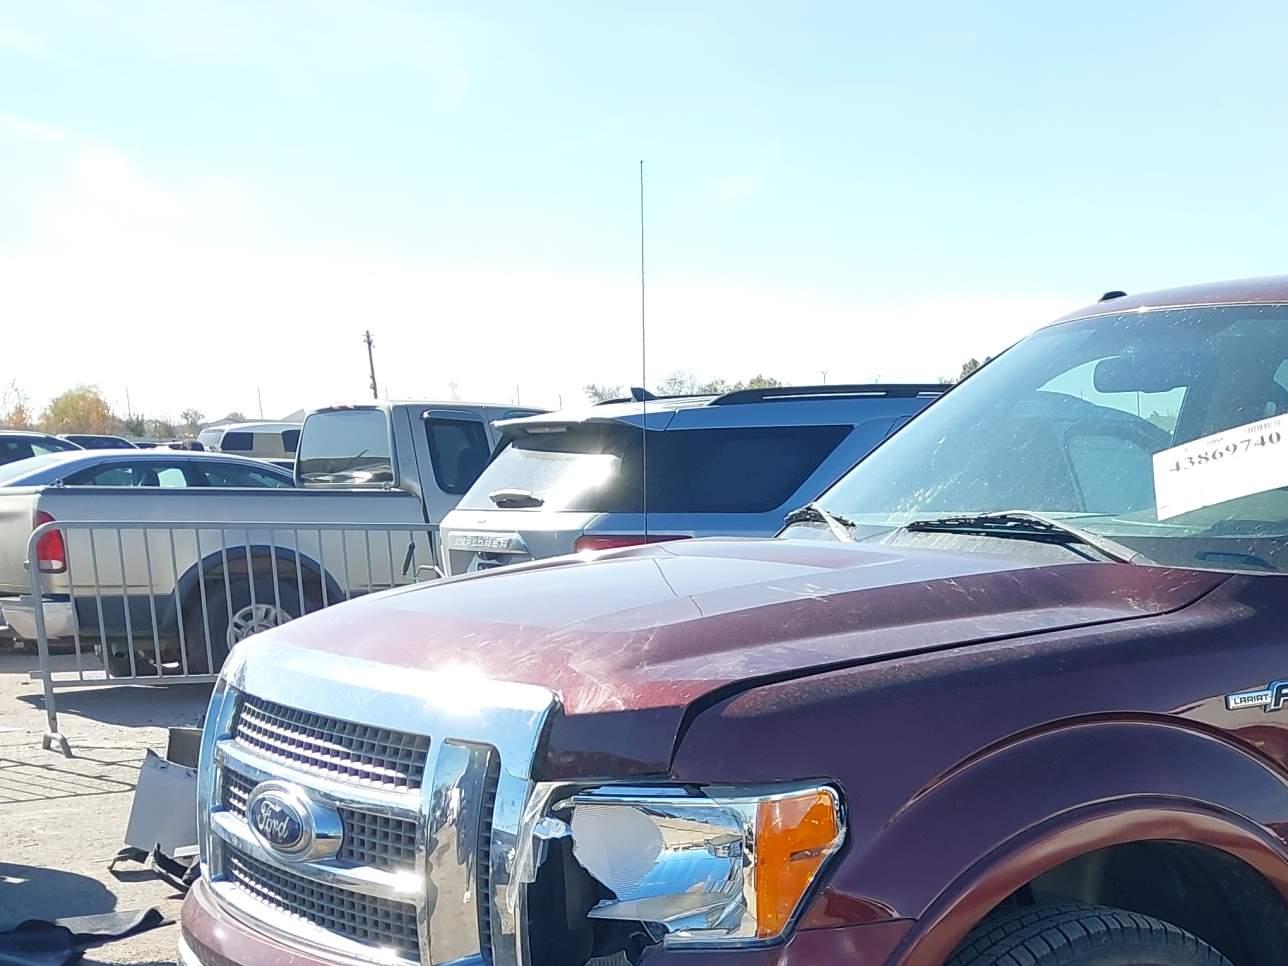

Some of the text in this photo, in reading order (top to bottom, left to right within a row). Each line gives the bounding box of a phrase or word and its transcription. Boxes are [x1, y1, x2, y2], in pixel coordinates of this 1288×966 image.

[1169, 431, 1281, 472] 43869740
[454, 535, 512, 548] EXPLORER
[1233, 693, 1269, 705] LARIAT
[257, 800, 290, 838] Ford
